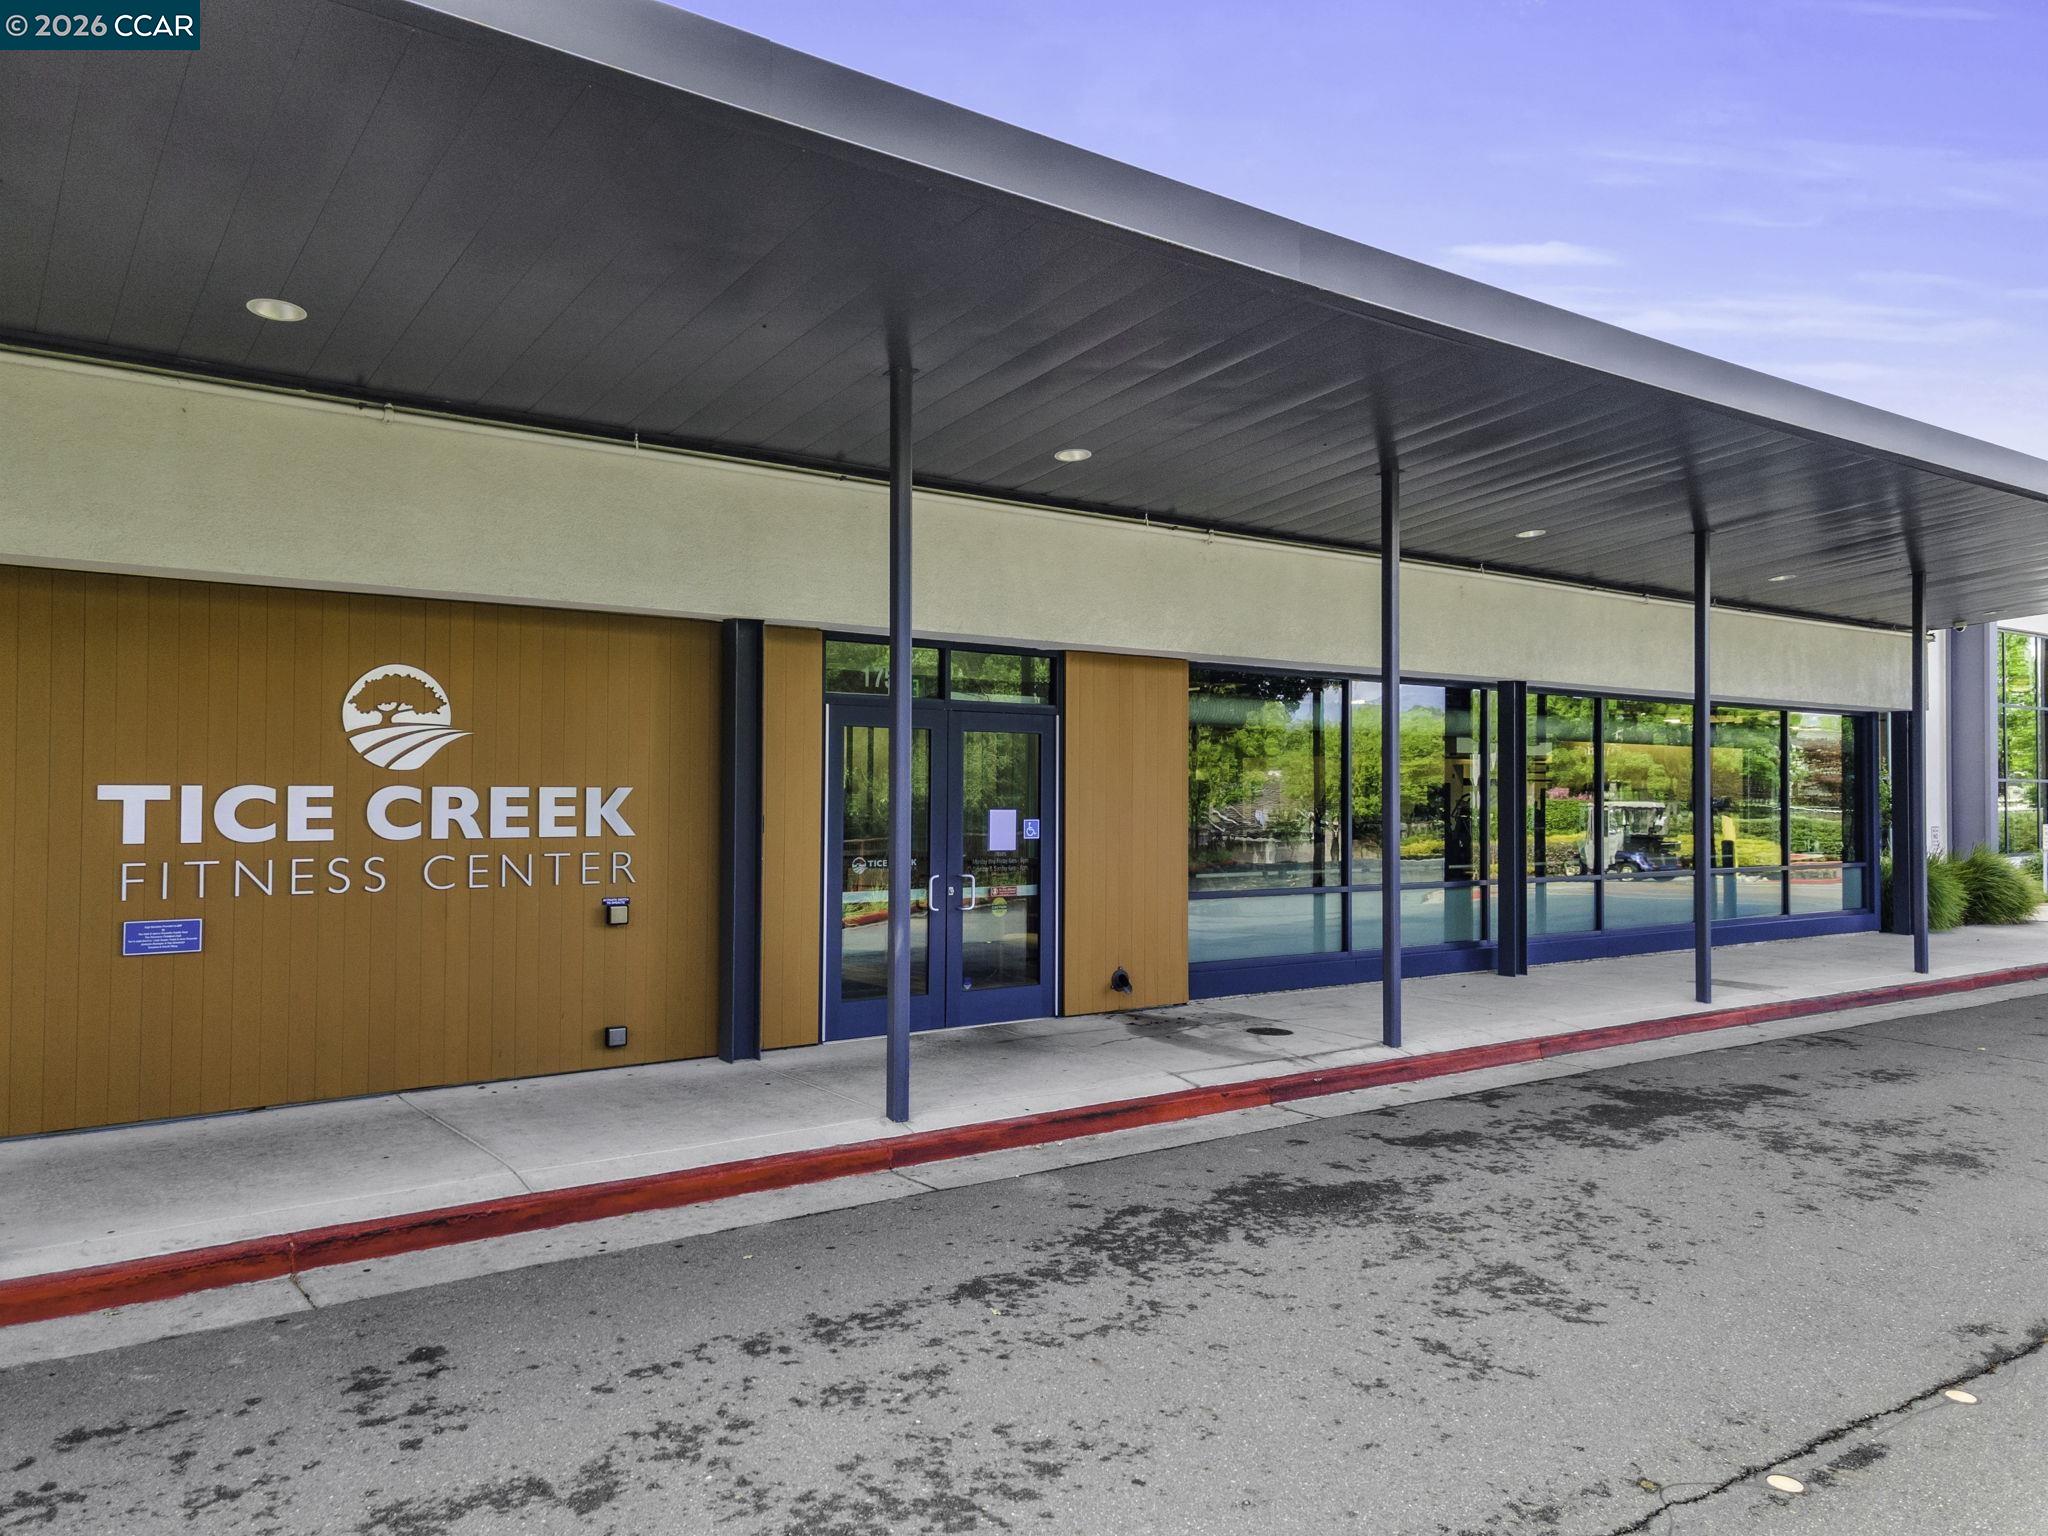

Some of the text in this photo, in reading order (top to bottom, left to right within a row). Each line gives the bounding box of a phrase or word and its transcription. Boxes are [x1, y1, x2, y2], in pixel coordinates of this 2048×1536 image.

[97, 784, 637, 845] TICE CREEK
[121, 851, 637, 902] FITNESS CENTER
[867, 859, 888, 868] TICE
